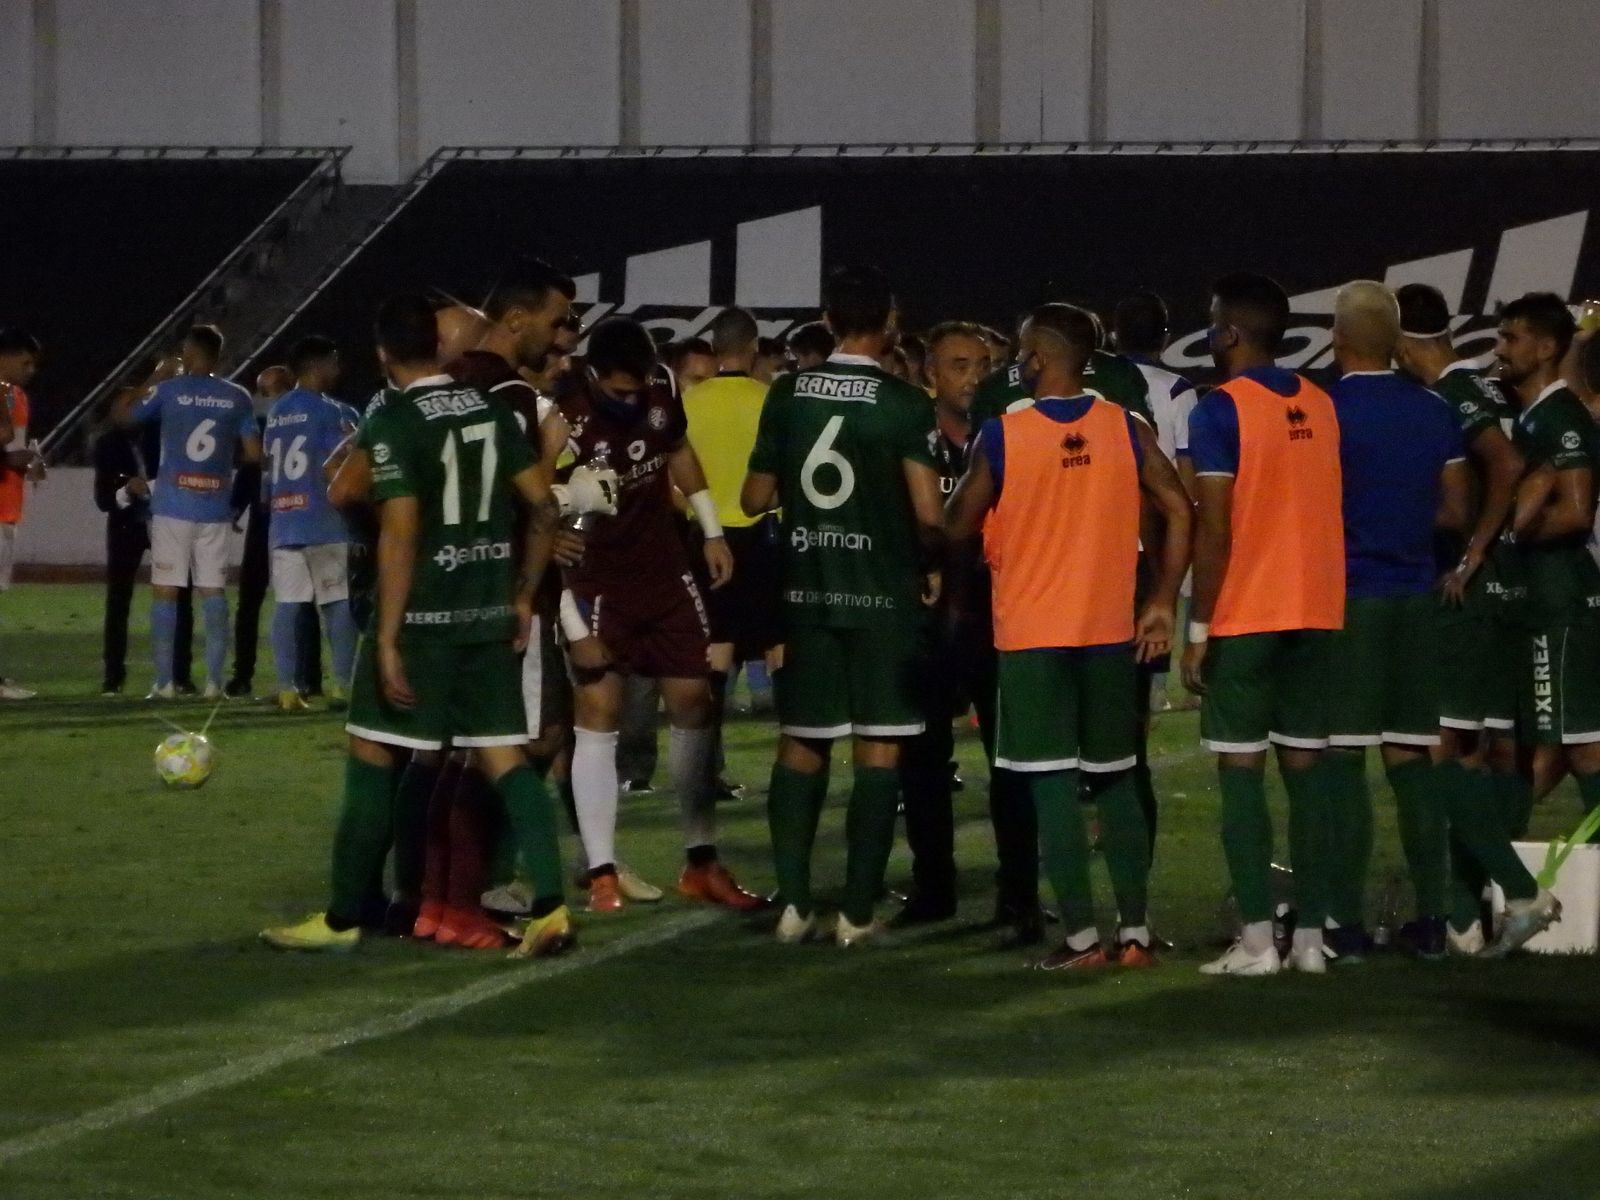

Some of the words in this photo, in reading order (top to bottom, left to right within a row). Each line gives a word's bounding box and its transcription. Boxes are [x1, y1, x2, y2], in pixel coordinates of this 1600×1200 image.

[795, 375, 880, 399] RANABE
[186, 418, 217, 462] 6
[270, 434, 308, 485] 16
[800, 415, 855, 510] 6
[440, 420, 498, 525] 17
[405, 610, 452, 624] XEREZ
[1533, 635, 1552, 713] XEREZ
